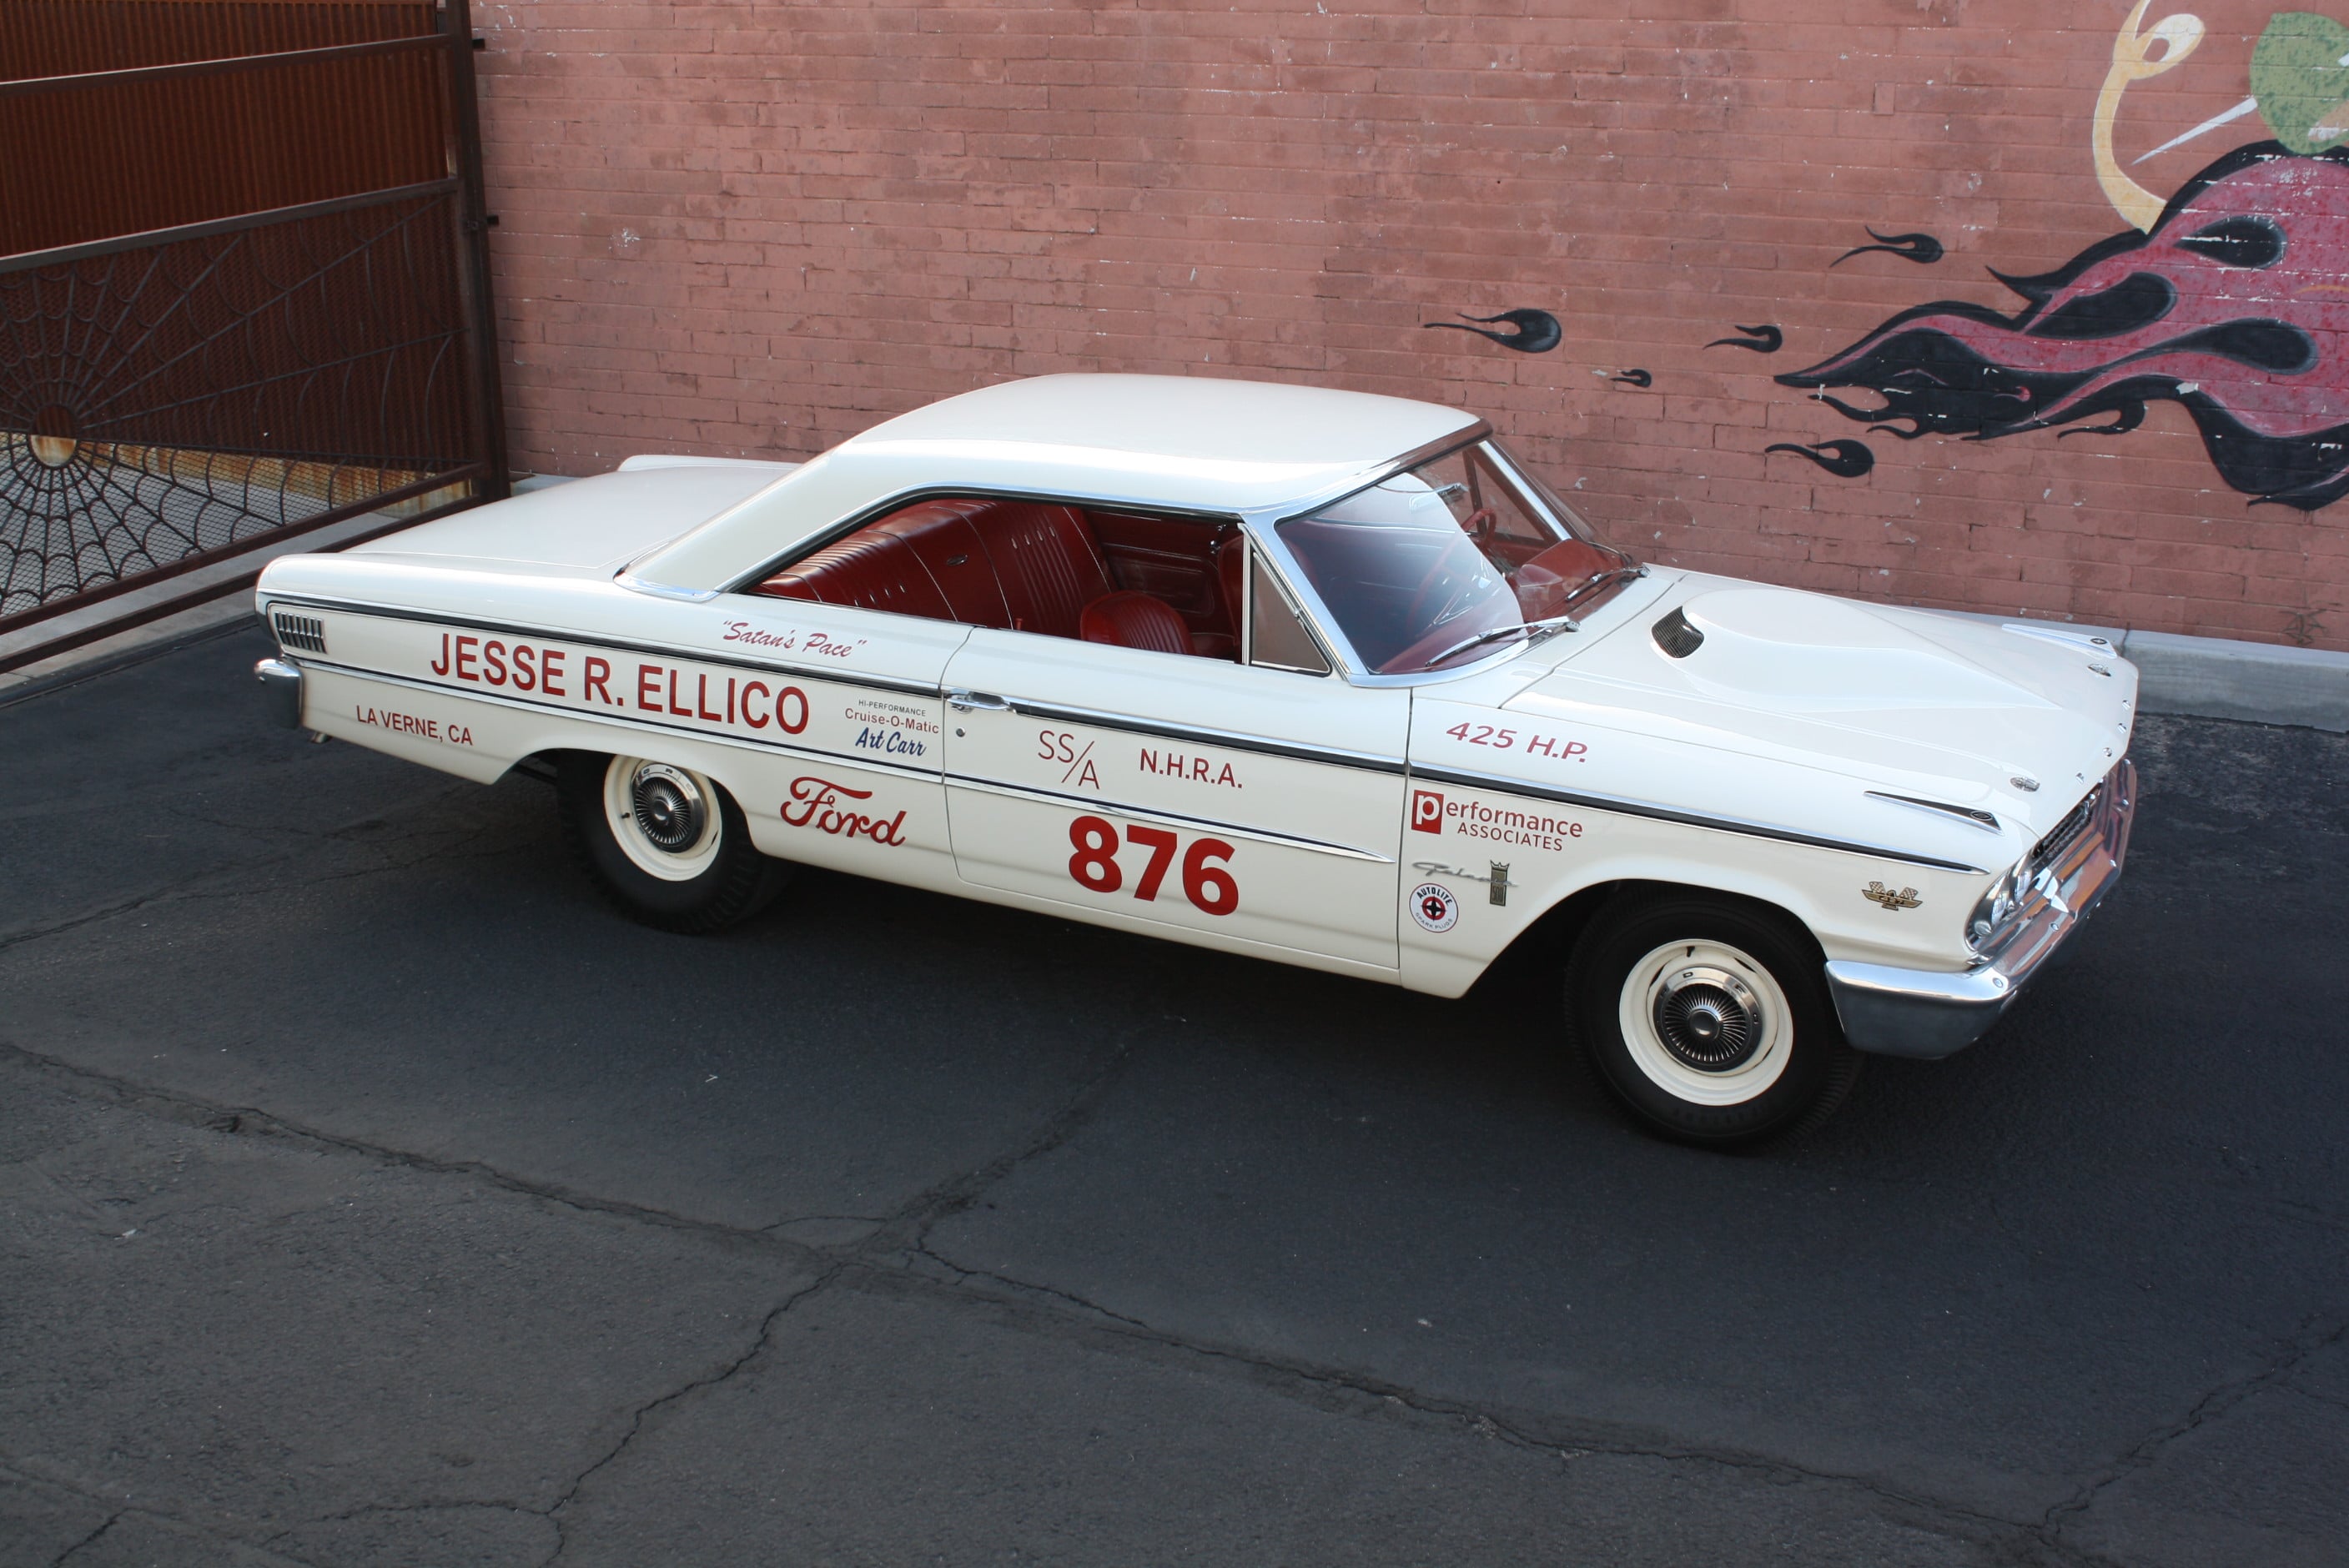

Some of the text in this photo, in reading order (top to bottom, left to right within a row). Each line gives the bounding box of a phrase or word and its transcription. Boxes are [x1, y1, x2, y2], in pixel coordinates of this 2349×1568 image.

[722, 620, 868, 657] "Satan's Pace"
[430, 633, 809, 735] JESSE R. ELLICO
[356, 705, 473, 745] LA VERNE, CA
[845, 707, 939, 734] Cruise-O-Matic
[858, 699, 926, 716] HI-PERFORMANCE
[855, 726, 927, 756] Art Carr
[1446, 722, 1588, 762] 425 H.P.
[1139, 748, 1243, 788] N.H.R.A.
[780, 776, 907, 847] Ford
[1457, 822, 1563, 851] ASSOCIATES
[1069, 815, 1239, 916] 876
[1416, 886, 1453, 907] AUTOLITE
